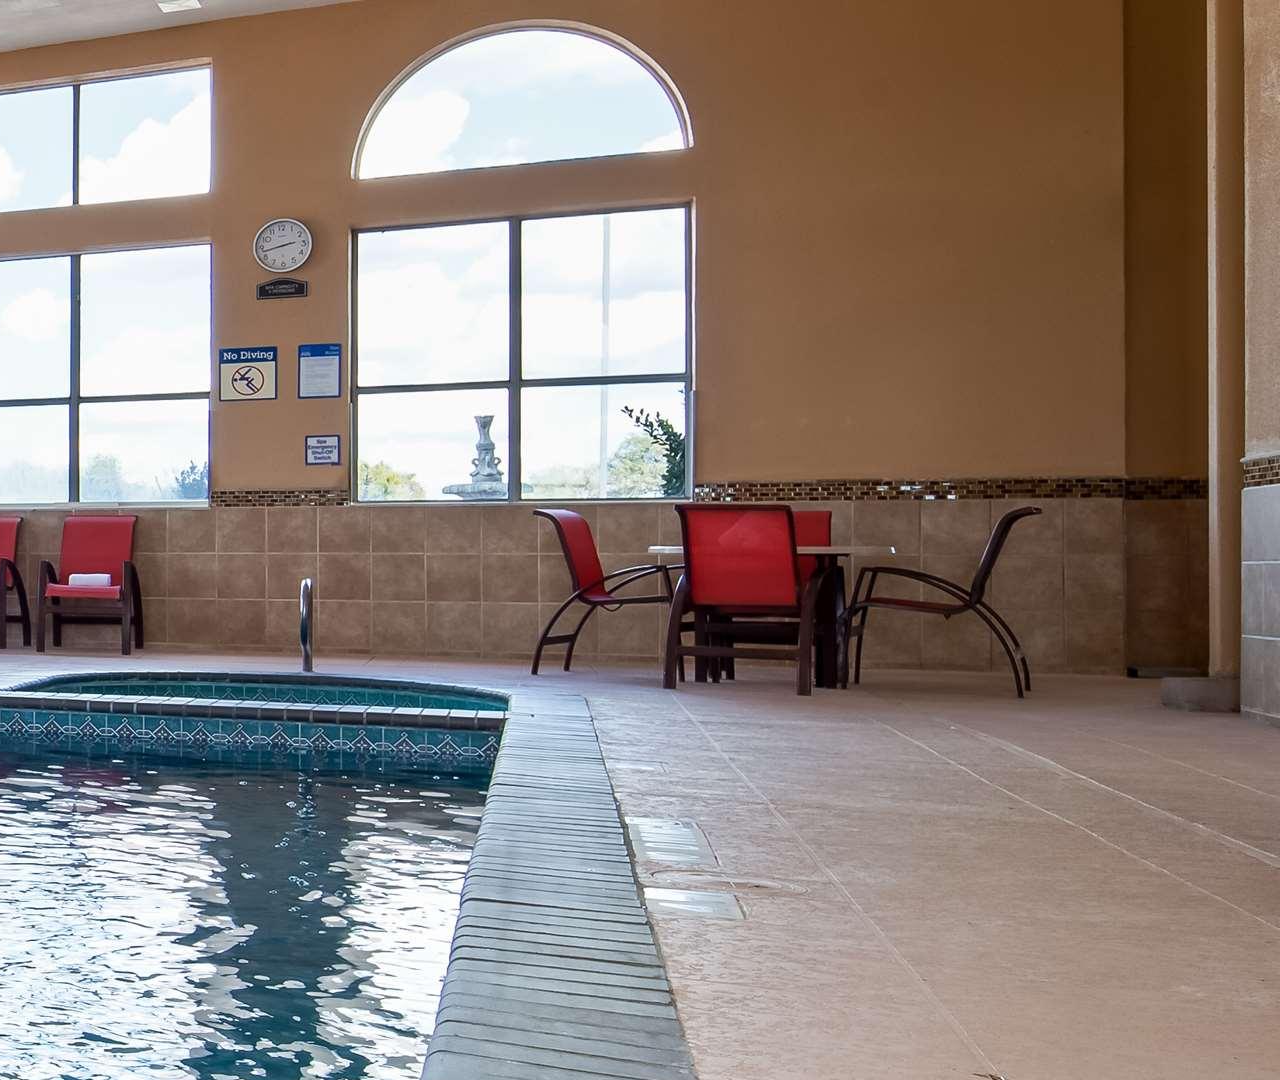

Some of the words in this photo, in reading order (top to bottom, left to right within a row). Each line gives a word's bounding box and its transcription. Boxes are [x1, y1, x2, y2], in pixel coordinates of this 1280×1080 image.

[278, 224, 286, 232] 12
[296, 230, 303, 238] 2
[223, 352, 238, 361] No
[240, 351, 274, 361] Diving
